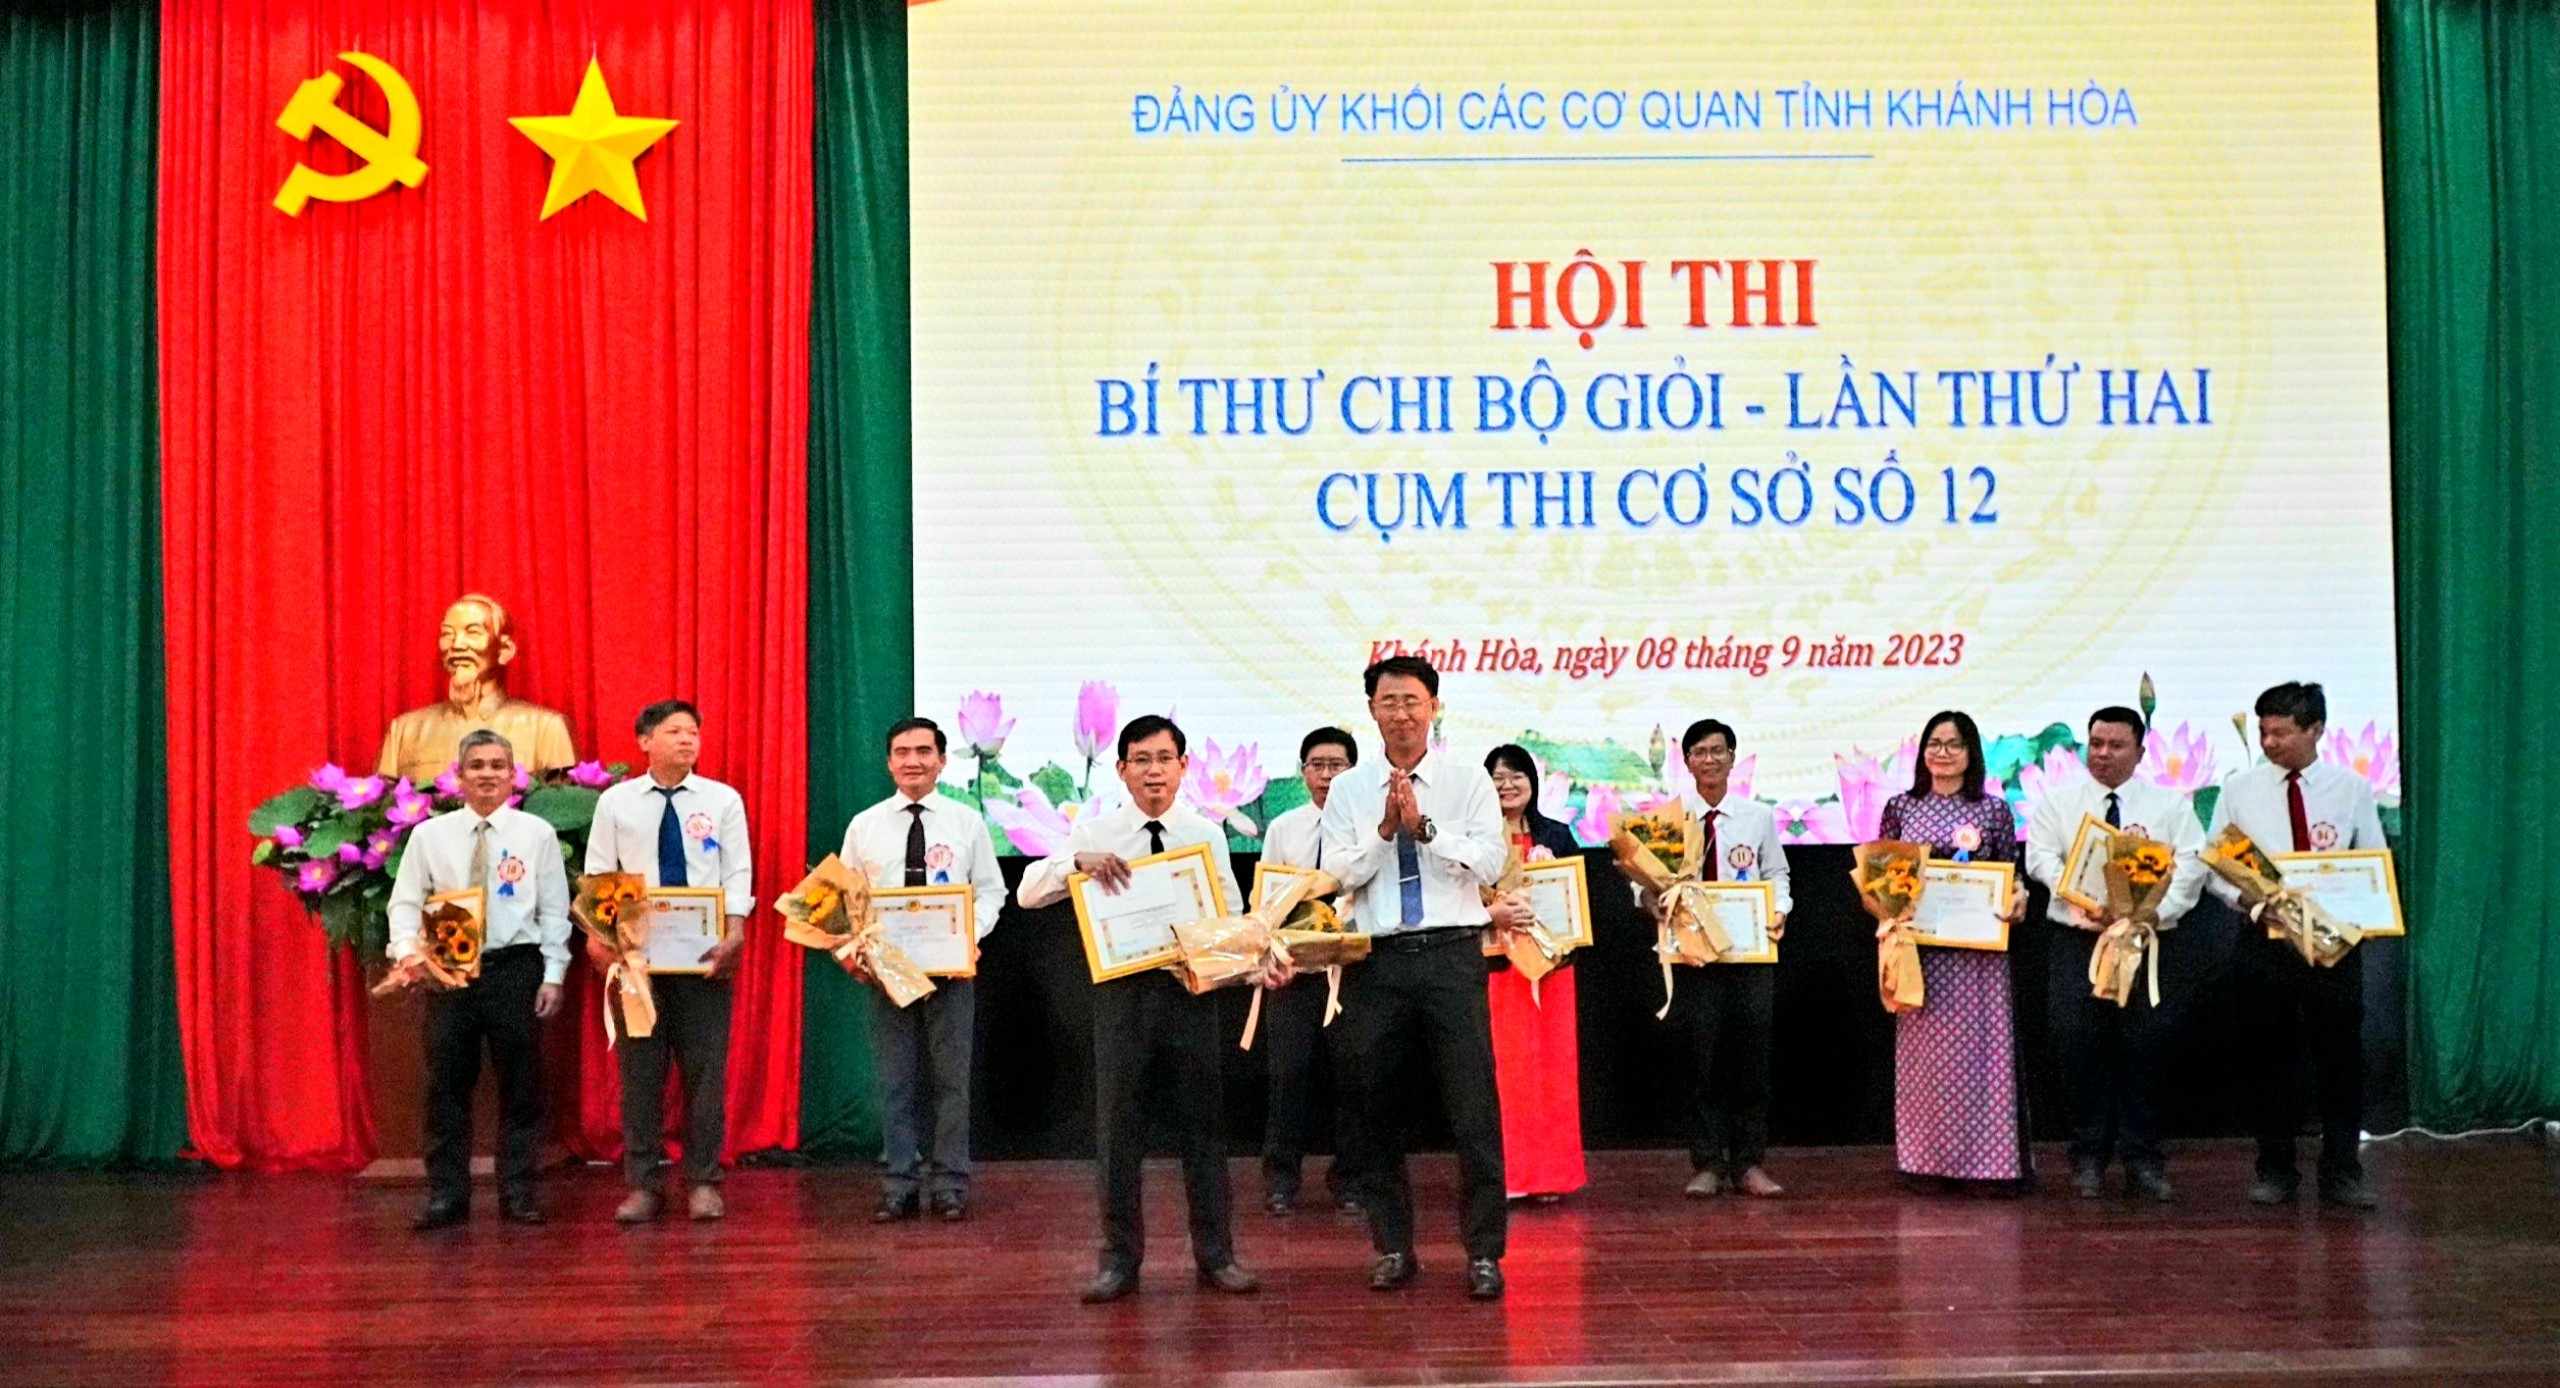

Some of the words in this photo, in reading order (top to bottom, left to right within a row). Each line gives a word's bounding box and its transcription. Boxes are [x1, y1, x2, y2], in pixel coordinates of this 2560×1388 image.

[1132, 85, 1255, 134] ĐẢNG
[1271, 84, 1326, 133] ỦY
[1341, 84, 1442, 131] KHỐI
[1458, 83, 1547, 131] CÁC
[1561, 90, 1627, 130] CƠ
[1640, 90, 1761, 130] QUAN
[1776, 81, 1871, 129] TỈNH
[1887, 81, 2032, 128] KHÁNH
[2048, 80, 2138, 127] HÒA
[1490, 248, 1647, 350] HỘI
[1671, 259, 1820, 329] THI
[1095, 362, 1160, 436] BÍ
[1178, 369, 1325, 435] THƯ
[1340, 374, 1454, 435] CHI
[1475, 358, 1567, 445] BỘ
[1585, 355, 1725, 432] GIỎI
[1745, 405, 1765, 414] -
[1785, 354, 1917, 430] LẦN
[1937, 354, 2080, 427] THỨ
[2097, 368, 2213, 426] HAI
[1316, 472, 1468, 543] CỤM
[1487, 470, 1597, 528] THI
[1617, 463, 1709, 529] CƠ
[1730, 451, 1815, 528] SỞ
[1833, 450, 1916, 526] SỐ
[1942, 466, 1998, 525] 12
[1475, 638, 1544, 674] Hòa,
[1552, 637, 1629, 680] ngày
[1635, 637, 1678, 670] 08
[1684, 636, 1774, 677] tháng
[1781, 636, 1801, 668] 9
[1808, 635, 1875, 668] năm
[1882, 633, 1966, 667] 2023
